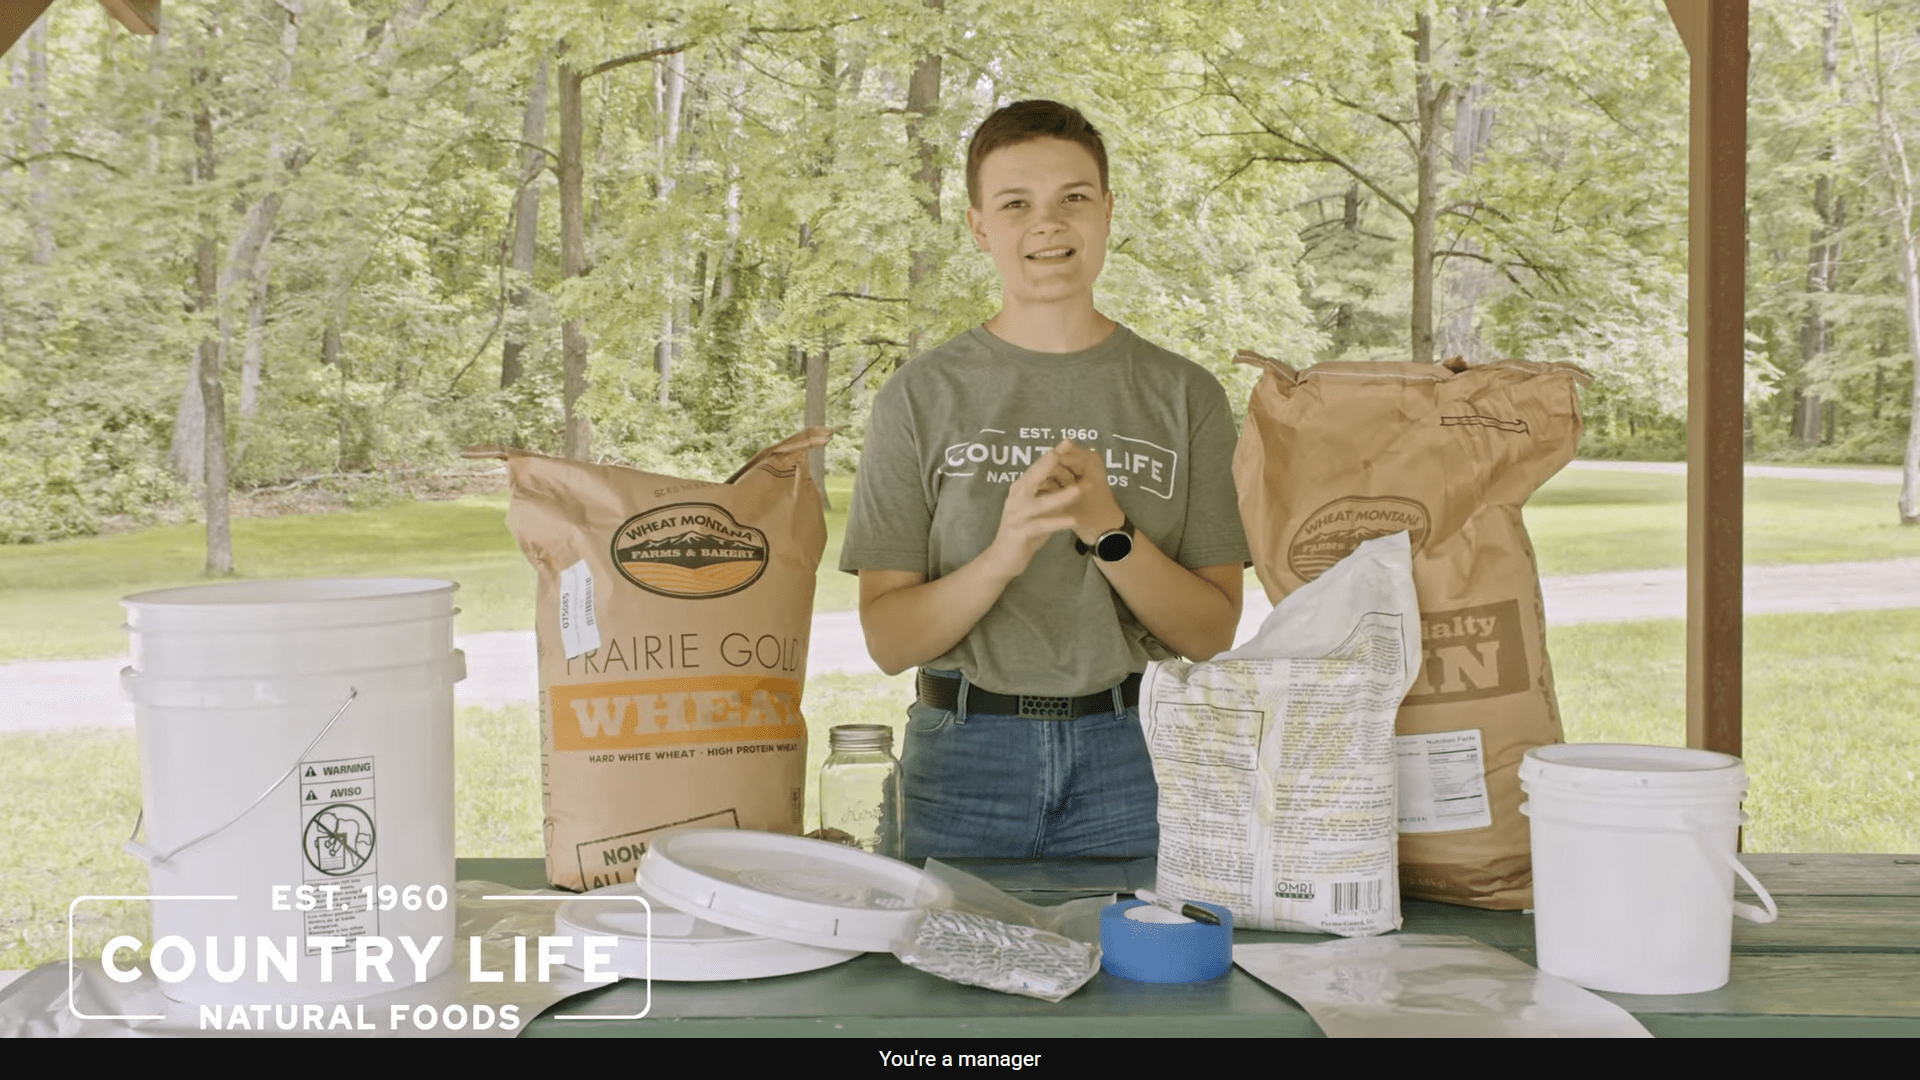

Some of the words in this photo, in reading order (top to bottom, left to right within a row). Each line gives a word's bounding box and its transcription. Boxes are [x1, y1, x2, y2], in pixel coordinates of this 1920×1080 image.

[1019, 427, 1055, 439] EST.
[1061, 428, 1099, 441] 1960
[947, 443, 1054, 467] COUNT
[1105, 448, 1164, 483] LIFE
[625, 516, 677, 541] WHEAT
[680, 515, 753, 542] MONTANA
[1305, 510, 1353, 535] WHEAT
[631, 548, 681, 560] FARMS
[685, 548, 697, 558] &
[701, 548, 755, 559] BAKERY
[561, 592, 570, 629] 075085
[1422, 615, 1497, 640] ialty
[720, 632, 799, 673] GOLD
[589, 754, 615, 763] HARD
[618, 752, 651, 762] WHITE
[655, 749, 696, 760] WHEAT
[707, 747, 733, 757] HIGH
[736, 744, 775, 755] PROTEIN
[775, 743, 798, 752] WHEAT
[322, 762, 371, 776] WARNING
[330, 786, 362, 798] AVISO
[603, 841, 647, 867] NON
[1277, 881, 1312, 894] OMRI
